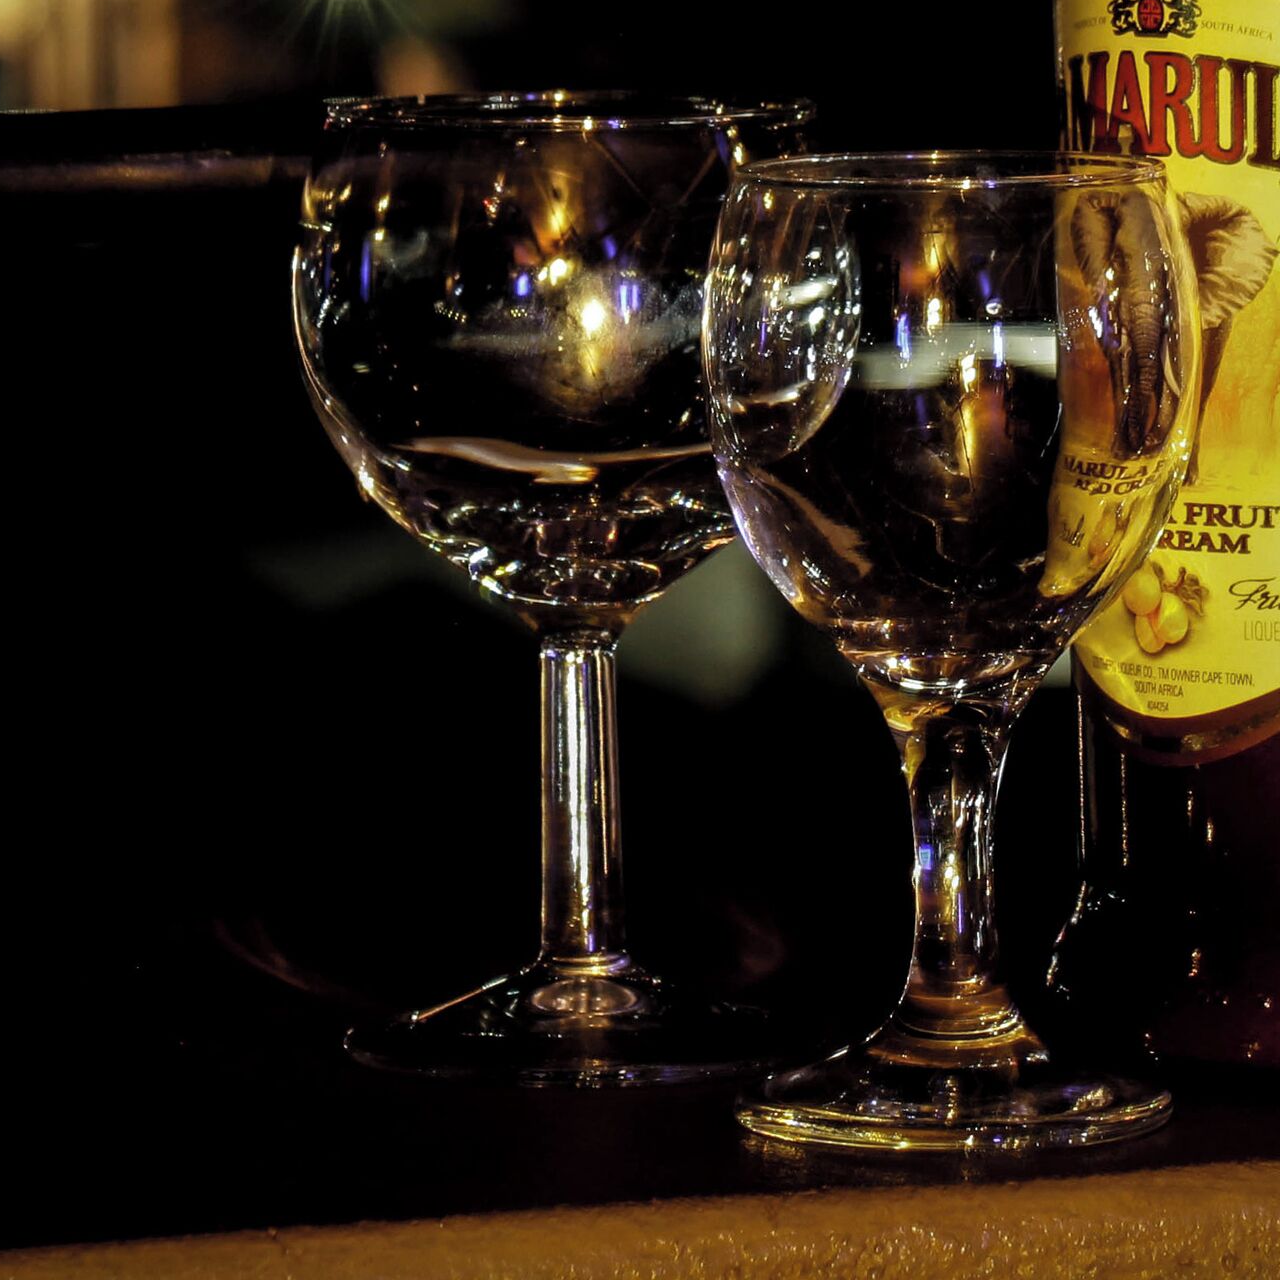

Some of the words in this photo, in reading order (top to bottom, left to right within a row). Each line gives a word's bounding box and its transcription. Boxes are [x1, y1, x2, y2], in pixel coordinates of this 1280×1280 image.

[1200, 19, 1234, 33] SOUTH
[1236, 23, 1274, 41] AFRICA
[1157, 666, 1169, 680] TM
[1170, 667, 1200, 683] OWNER
[1201, 671, 1223, 685] CAPE
[1134, 680, 1156, 694] SOUTH
[1158, 683, 1185, 697] AFRICA
